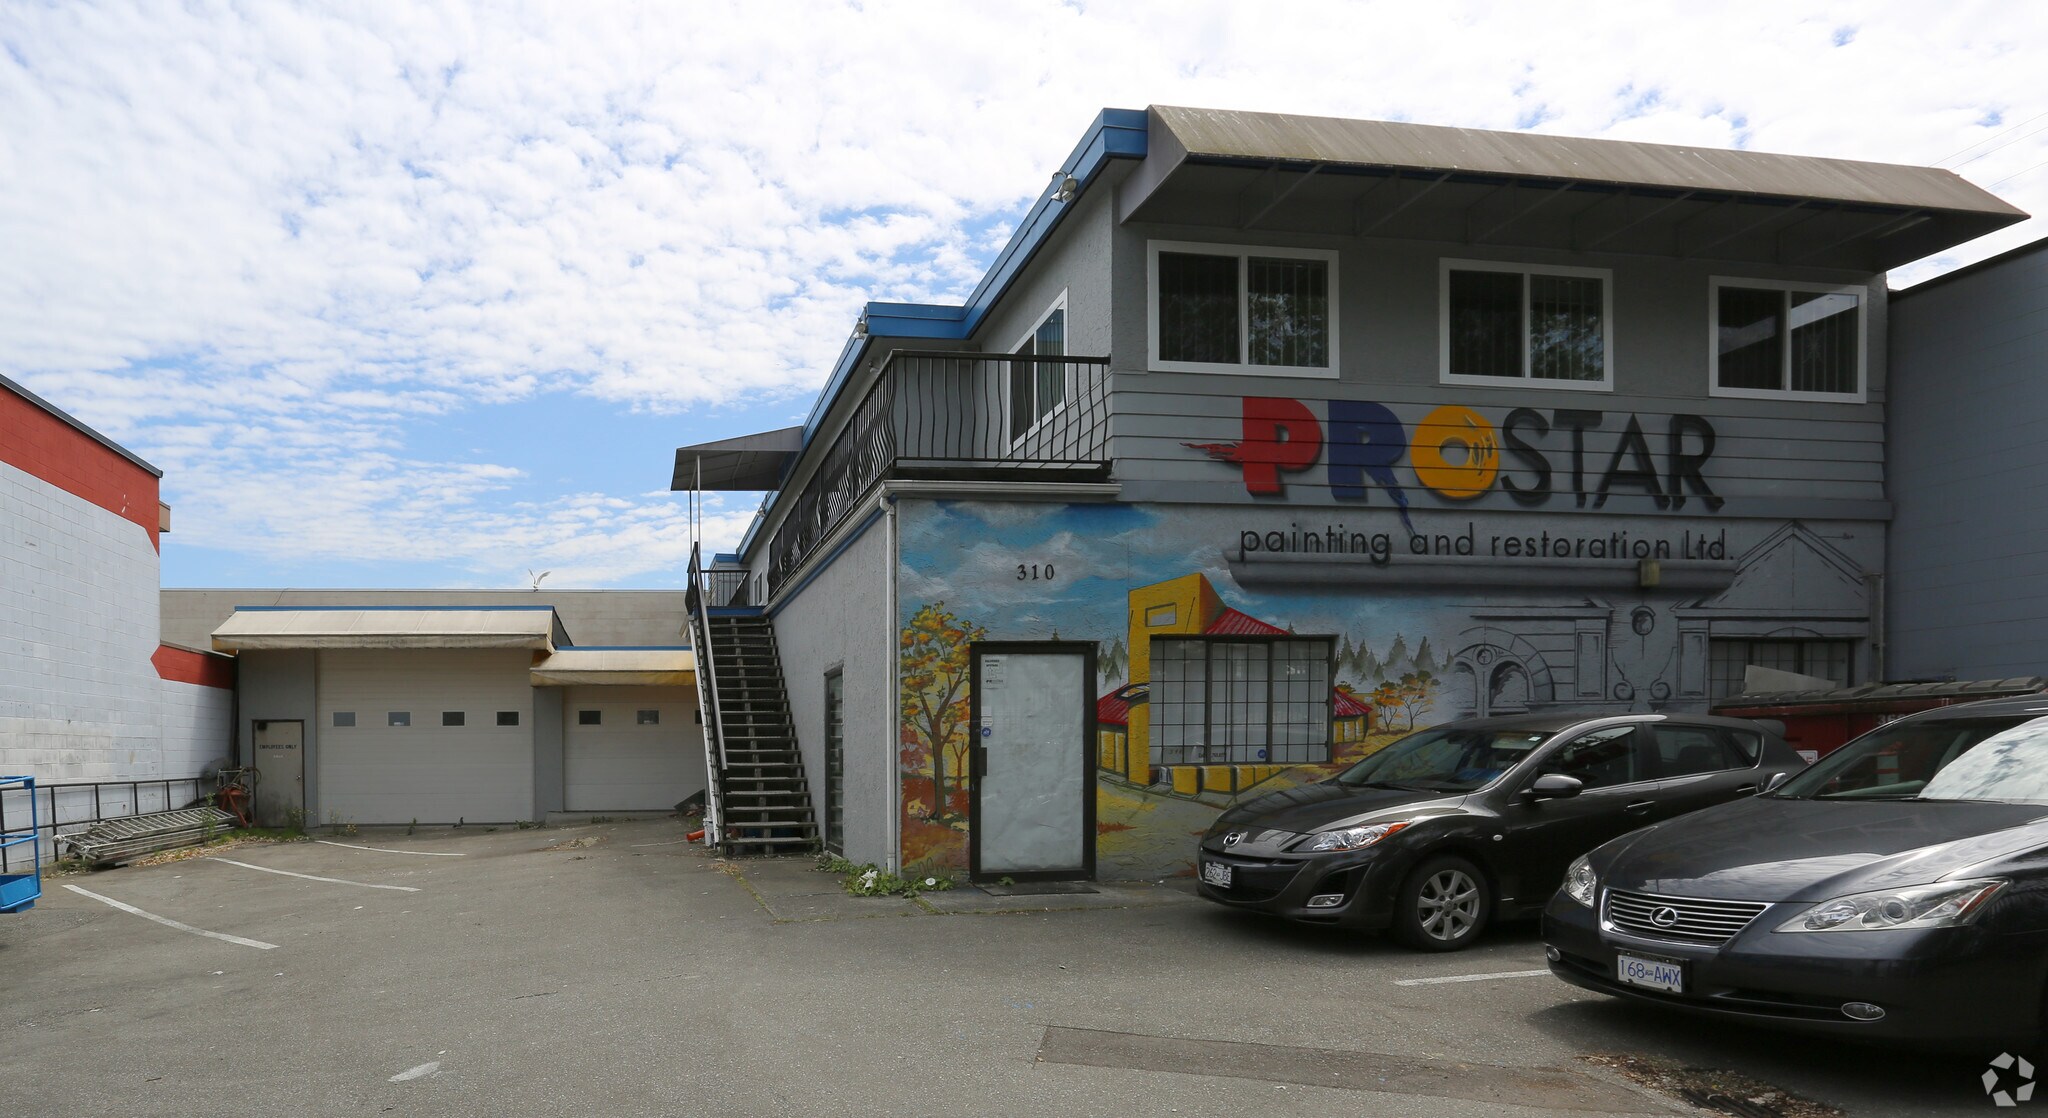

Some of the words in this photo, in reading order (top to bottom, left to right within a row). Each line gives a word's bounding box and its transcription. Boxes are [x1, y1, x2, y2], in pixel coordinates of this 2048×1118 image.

[1187, 396, 1725, 513] PROSTAR
[1239, 522, 1390, 567] painting
[1409, 521, 1474, 556] and
[1491, 530, 1670, 560] restoration
[1684, 528, 1735, 561] Ltd.
[1016, 563, 1056, 581] 310
[1620, 959, 1645, 979] 168
[1653, 965, 1681, 987] AWX
